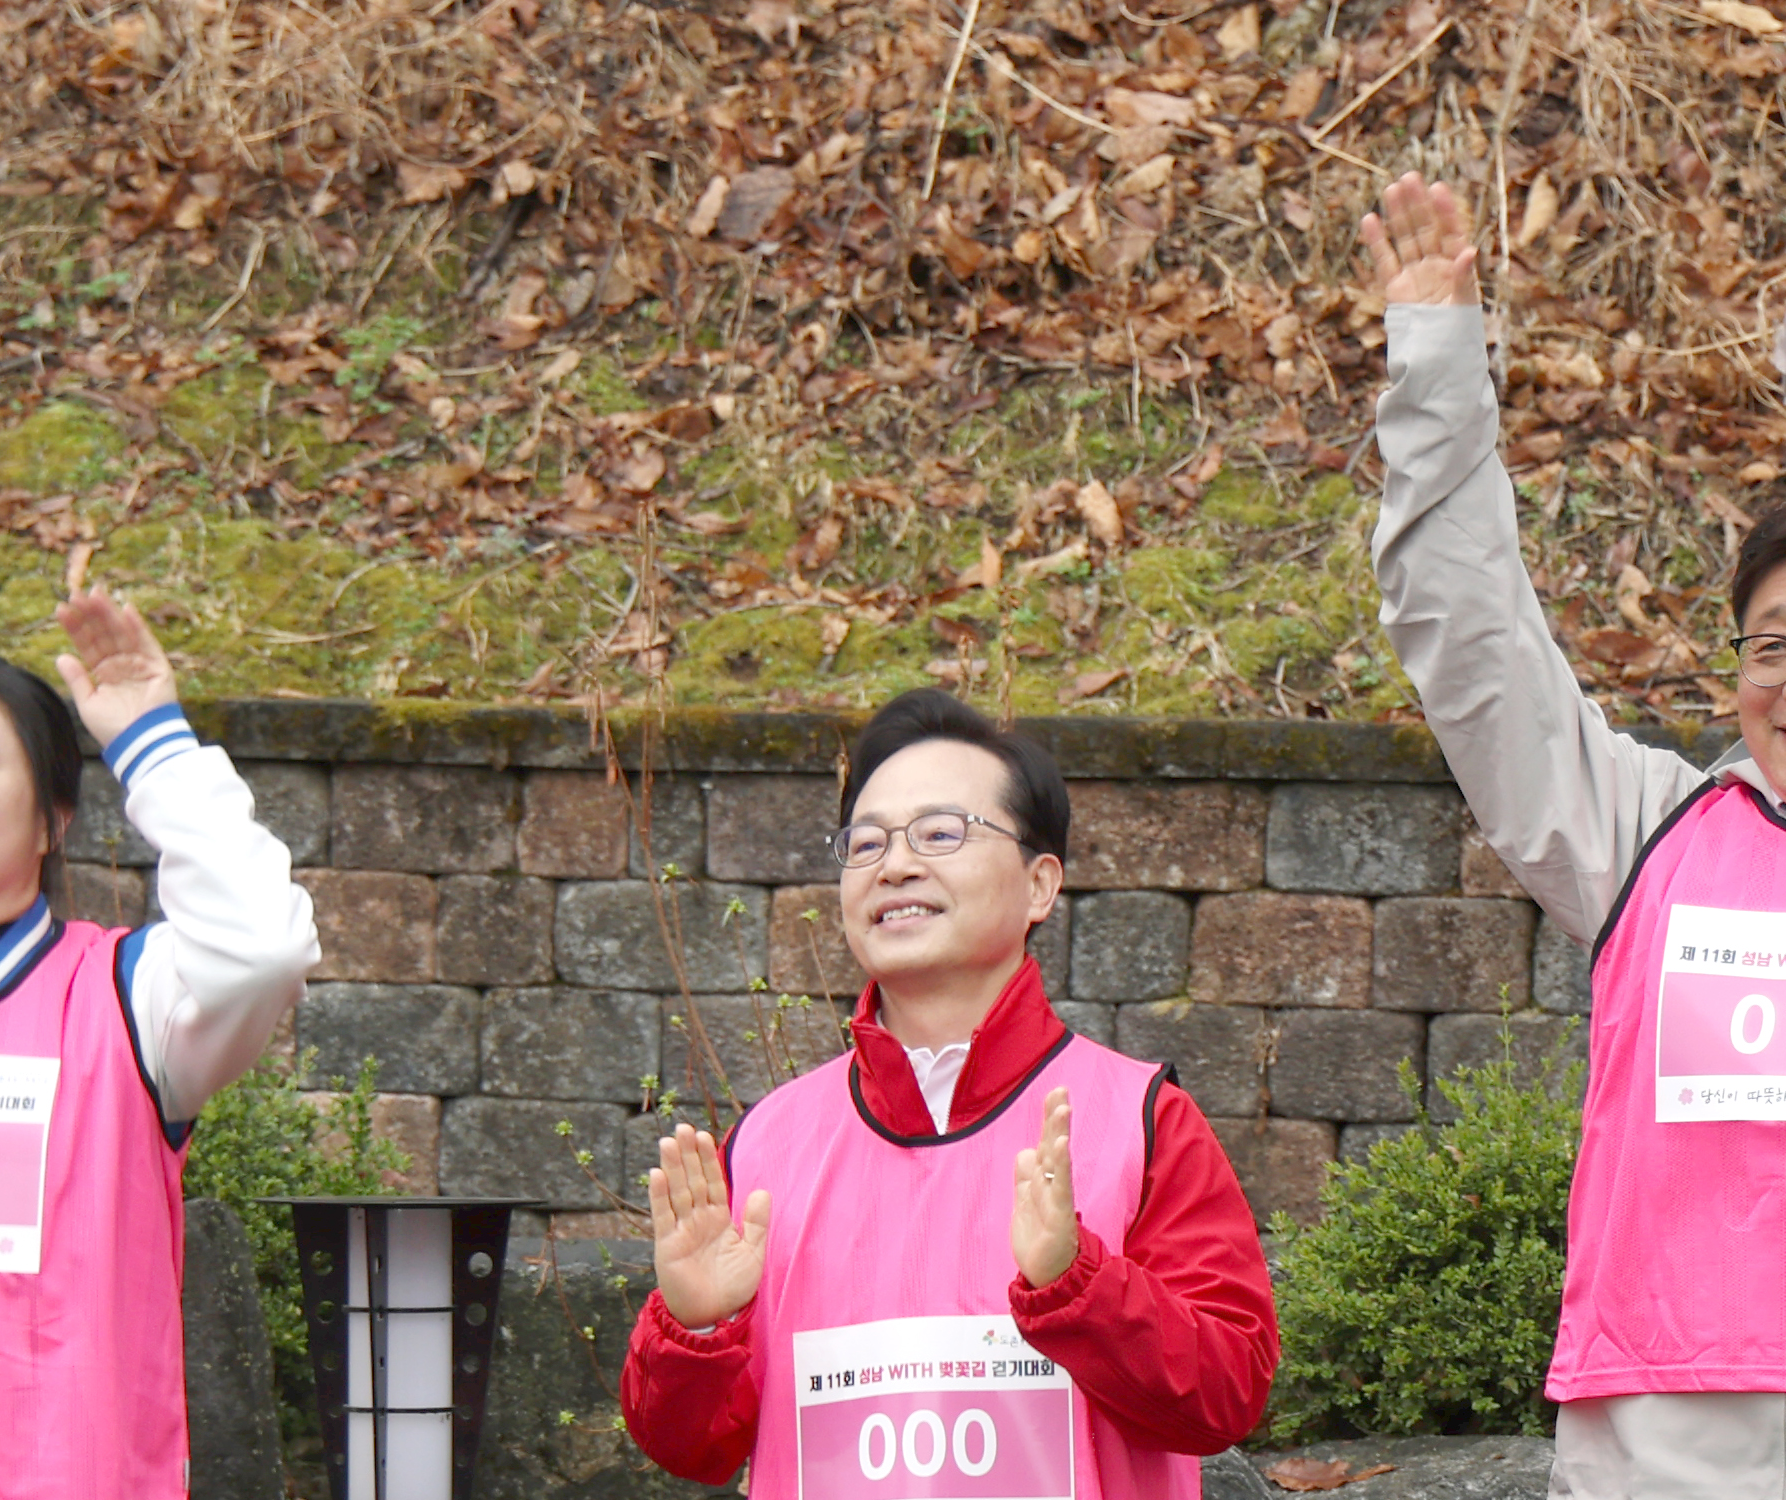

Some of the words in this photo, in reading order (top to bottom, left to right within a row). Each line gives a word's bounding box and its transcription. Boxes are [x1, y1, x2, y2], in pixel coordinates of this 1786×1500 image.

[1679, 946, 1695, 961] 제
[1702, 948, 1736, 964] 11회
[1742, 951, 1772, 968] 성남
[1701, 1089, 1737, 1104] 당신이
[810, 1375, 822, 1392] 제
[828, 1370, 855, 1388] 11회
[859, 1366, 883, 1385] 성남
[888, 1362, 932, 1379] WITH
[940, 1361, 986, 1378] 벚꽃길
[992, 1359, 1054, 1377] 걷기대회
[859, 1408, 997, 1480] 000
